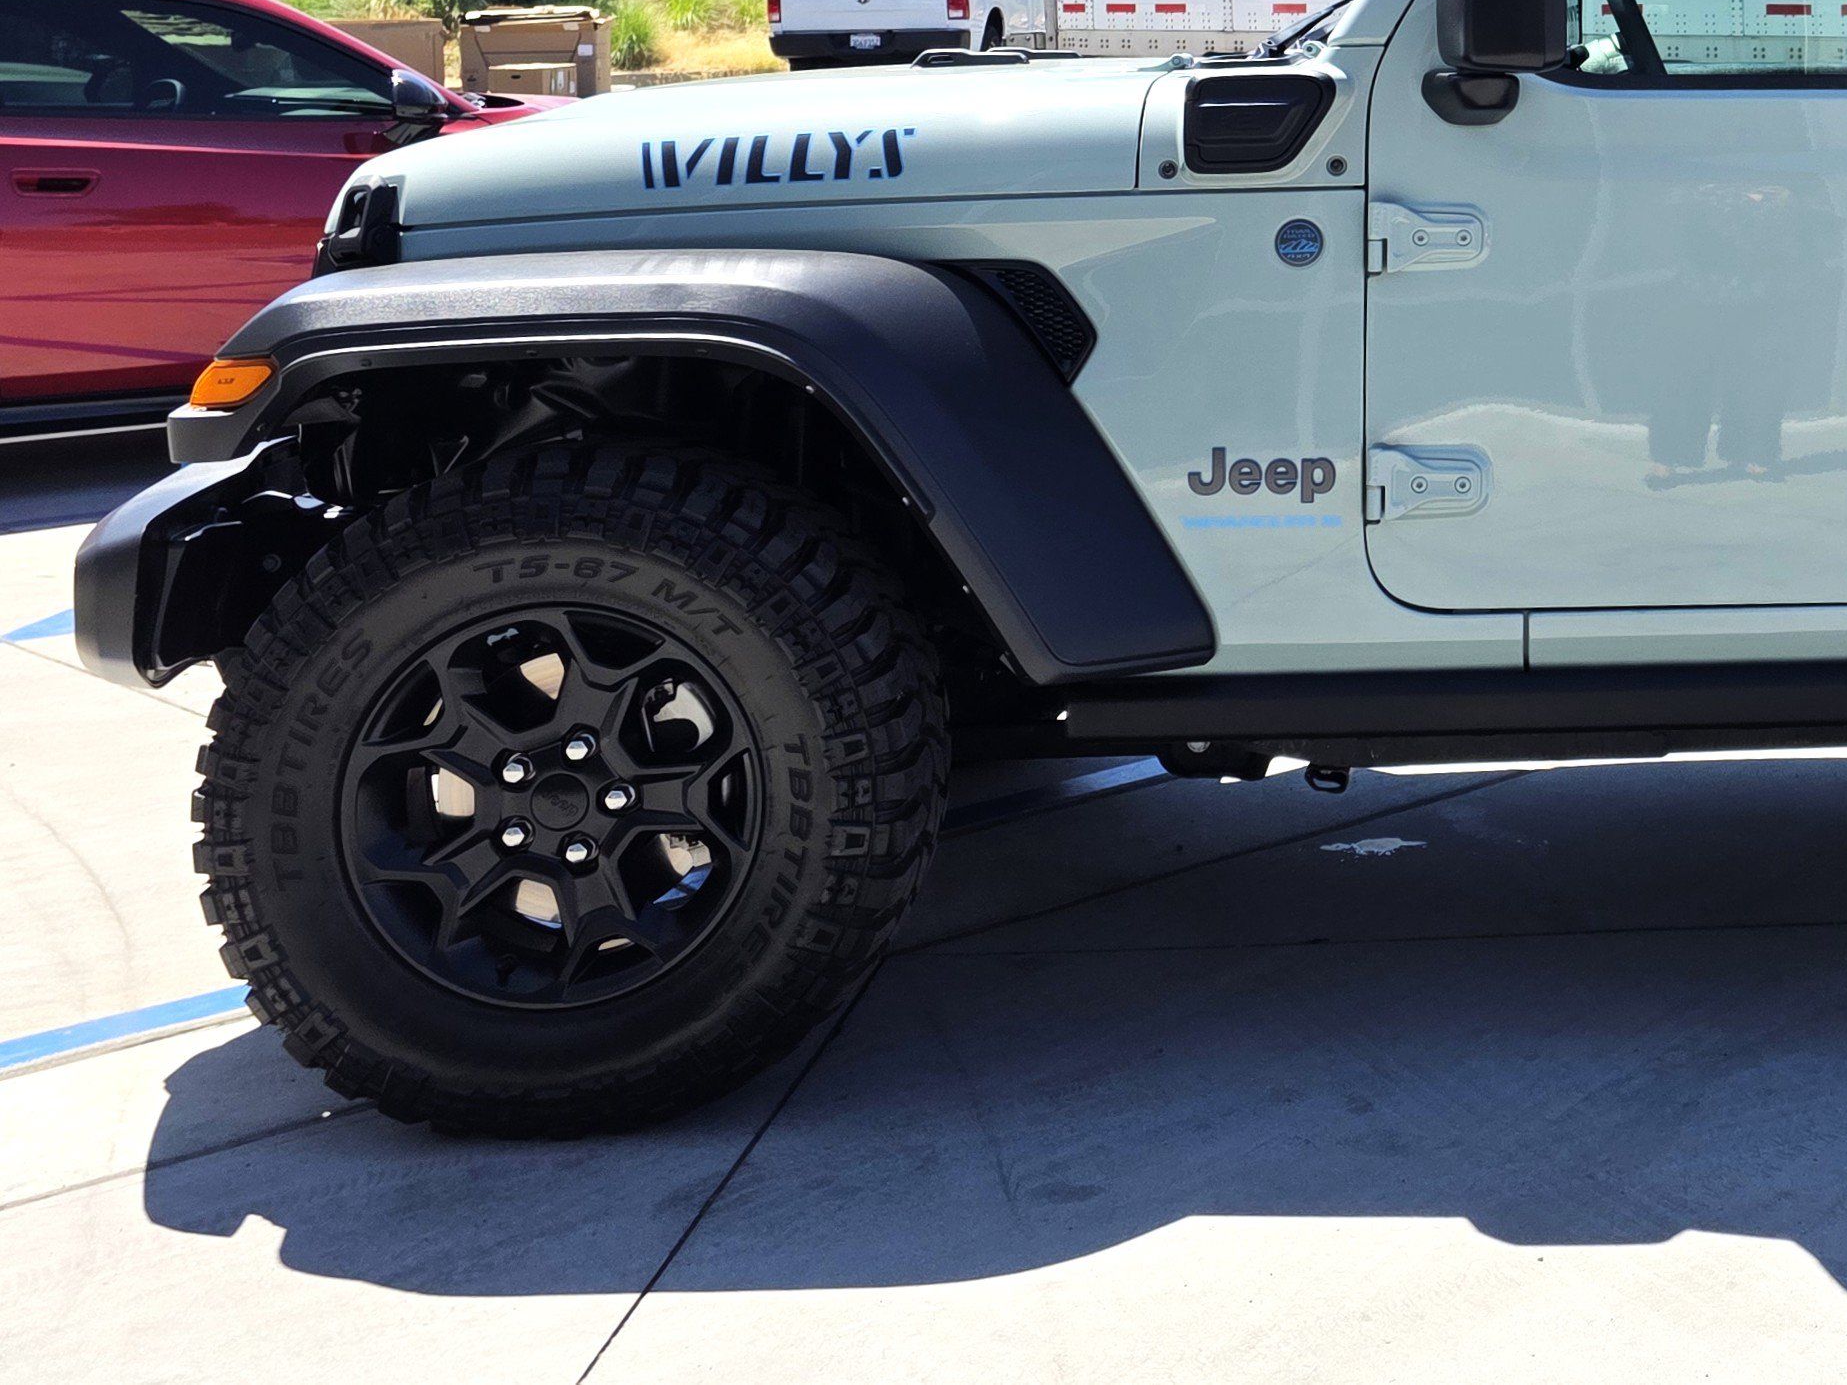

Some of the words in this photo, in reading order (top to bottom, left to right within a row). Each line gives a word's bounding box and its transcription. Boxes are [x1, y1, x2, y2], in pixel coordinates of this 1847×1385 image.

[641, 127, 917, 190] WILLYS
[1187, 446, 1337, 504] Jeep
[472, 553, 640, 584] TS-67
[269, 628, 372, 892] TBBTIRES
